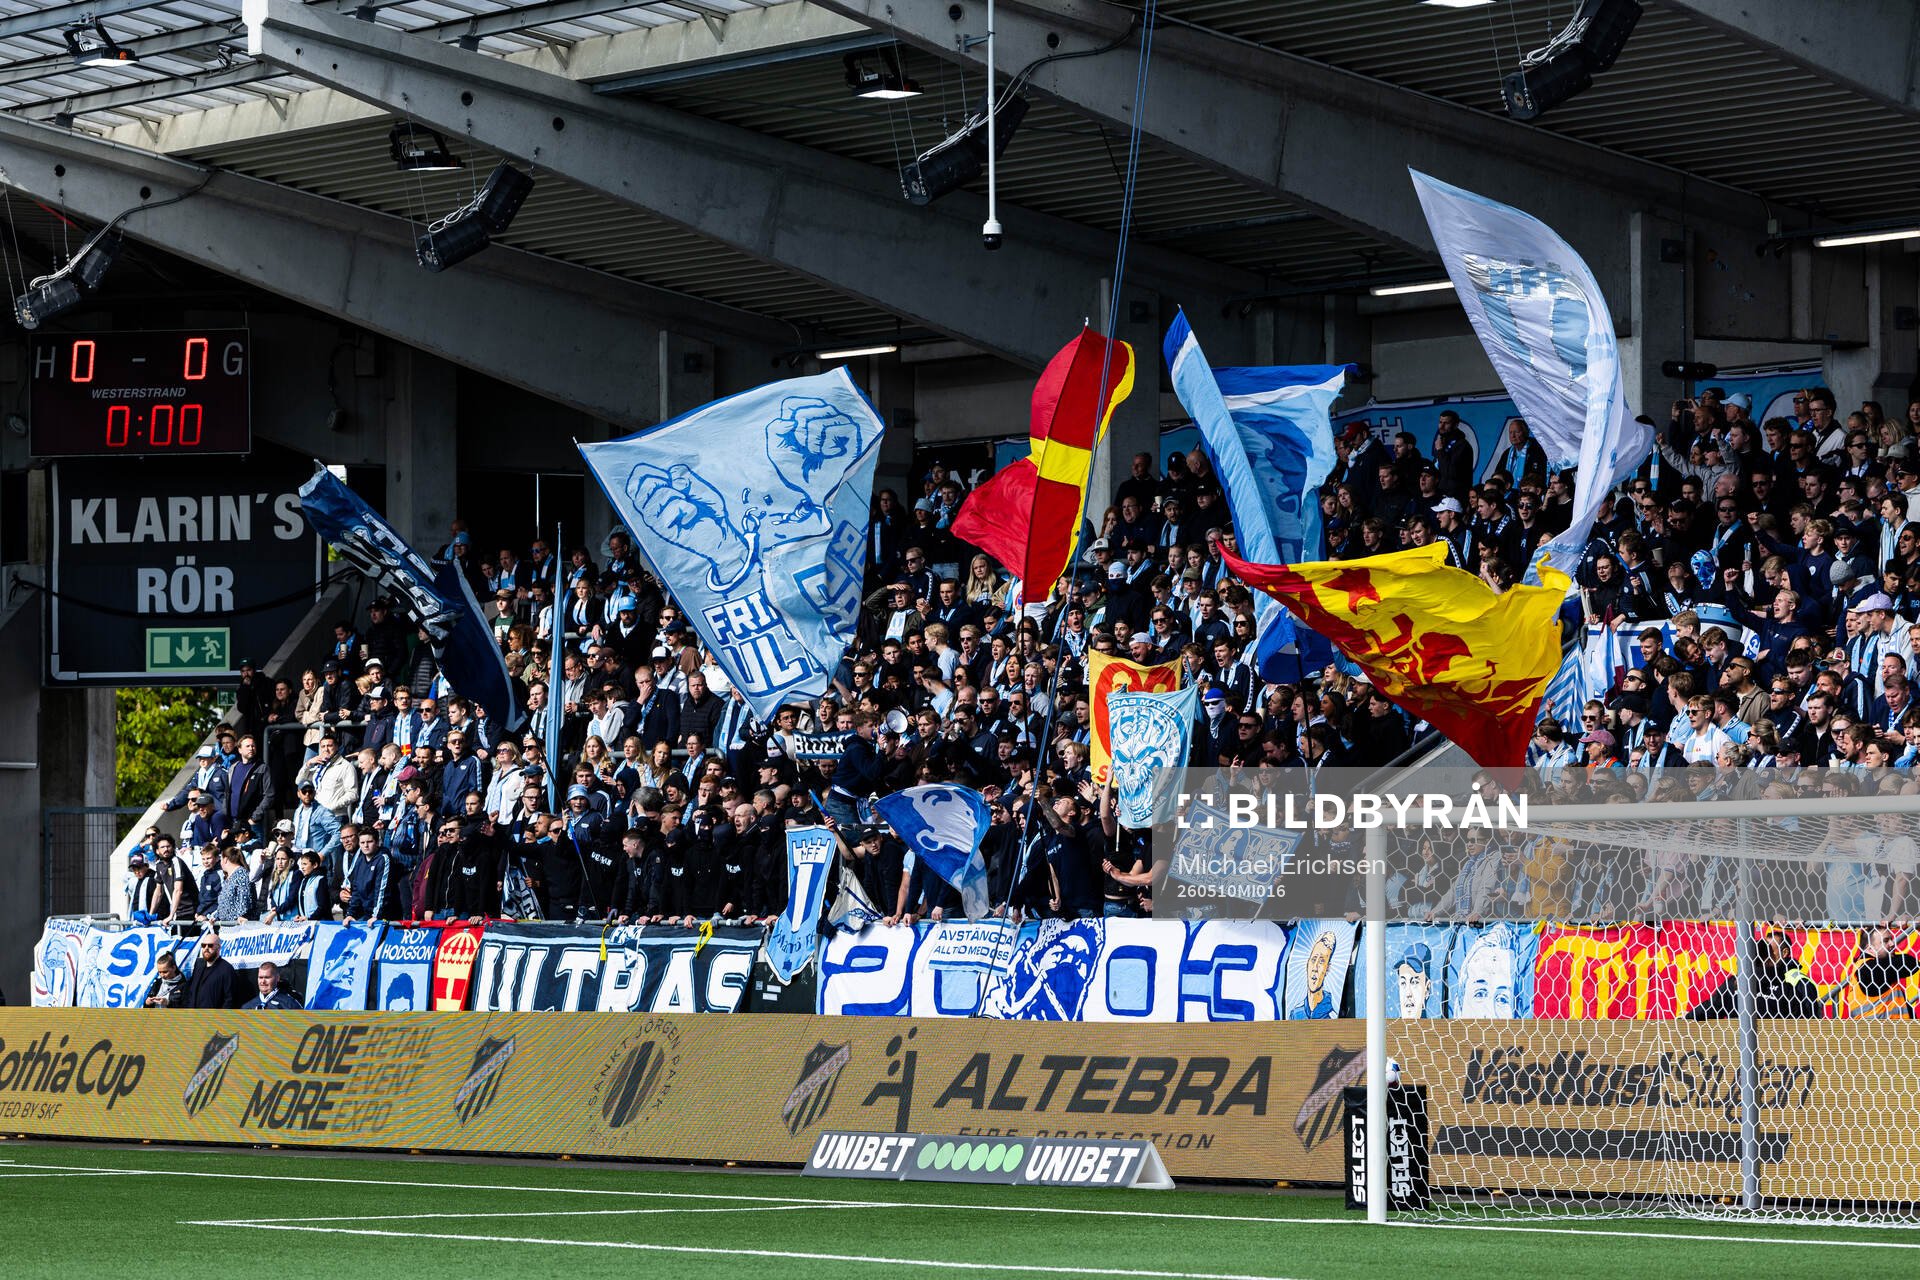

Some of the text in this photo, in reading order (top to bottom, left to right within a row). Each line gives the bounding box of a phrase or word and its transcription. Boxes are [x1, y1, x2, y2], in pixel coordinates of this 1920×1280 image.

[34, 346, 56, 379] H
[71, 340, 95, 383] 0
[184, 338, 208, 380] 0
[222, 341, 244, 376] G
[91, 386, 187, 399] WESTERSTRAND
[106, 404, 203, 447] 0:00
[137, 555, 235, 614] RÖR
[702, 590, 780, 645] FRI
[721, 632, 822, 696] UL
[381, 943, 434, 961] HODGSON
[401, 928, 430, 945] ROY
[938, 927, 1014, 947] AVSTÄNGDA
[473, 941, 755, 1013] ULTRAS
[291, 1023, 369, 1074] ONE
[361, 1026, 436, 1060] RETAIL
[0, 1031, 78, 1094] othia
[76, 1038, 146, 1110] Cup
[344, 1063, 425, 1096] EVENT
[933, 1052, 1273, 1116] ALTEBRA
[0, 1101, 63, 1119] TED BY SKF
[239, 1079, 345, 1131] MORE
[329, 1100, 393, 1133] EXPO
[812, 1134, 915, 1172] UNIBET
[1024, 1145, 1141, 1183] UNIBET
[1351, 1114, 1367, 1203] SELECT
[1388, 1116, 1412, 1198] SELECT
